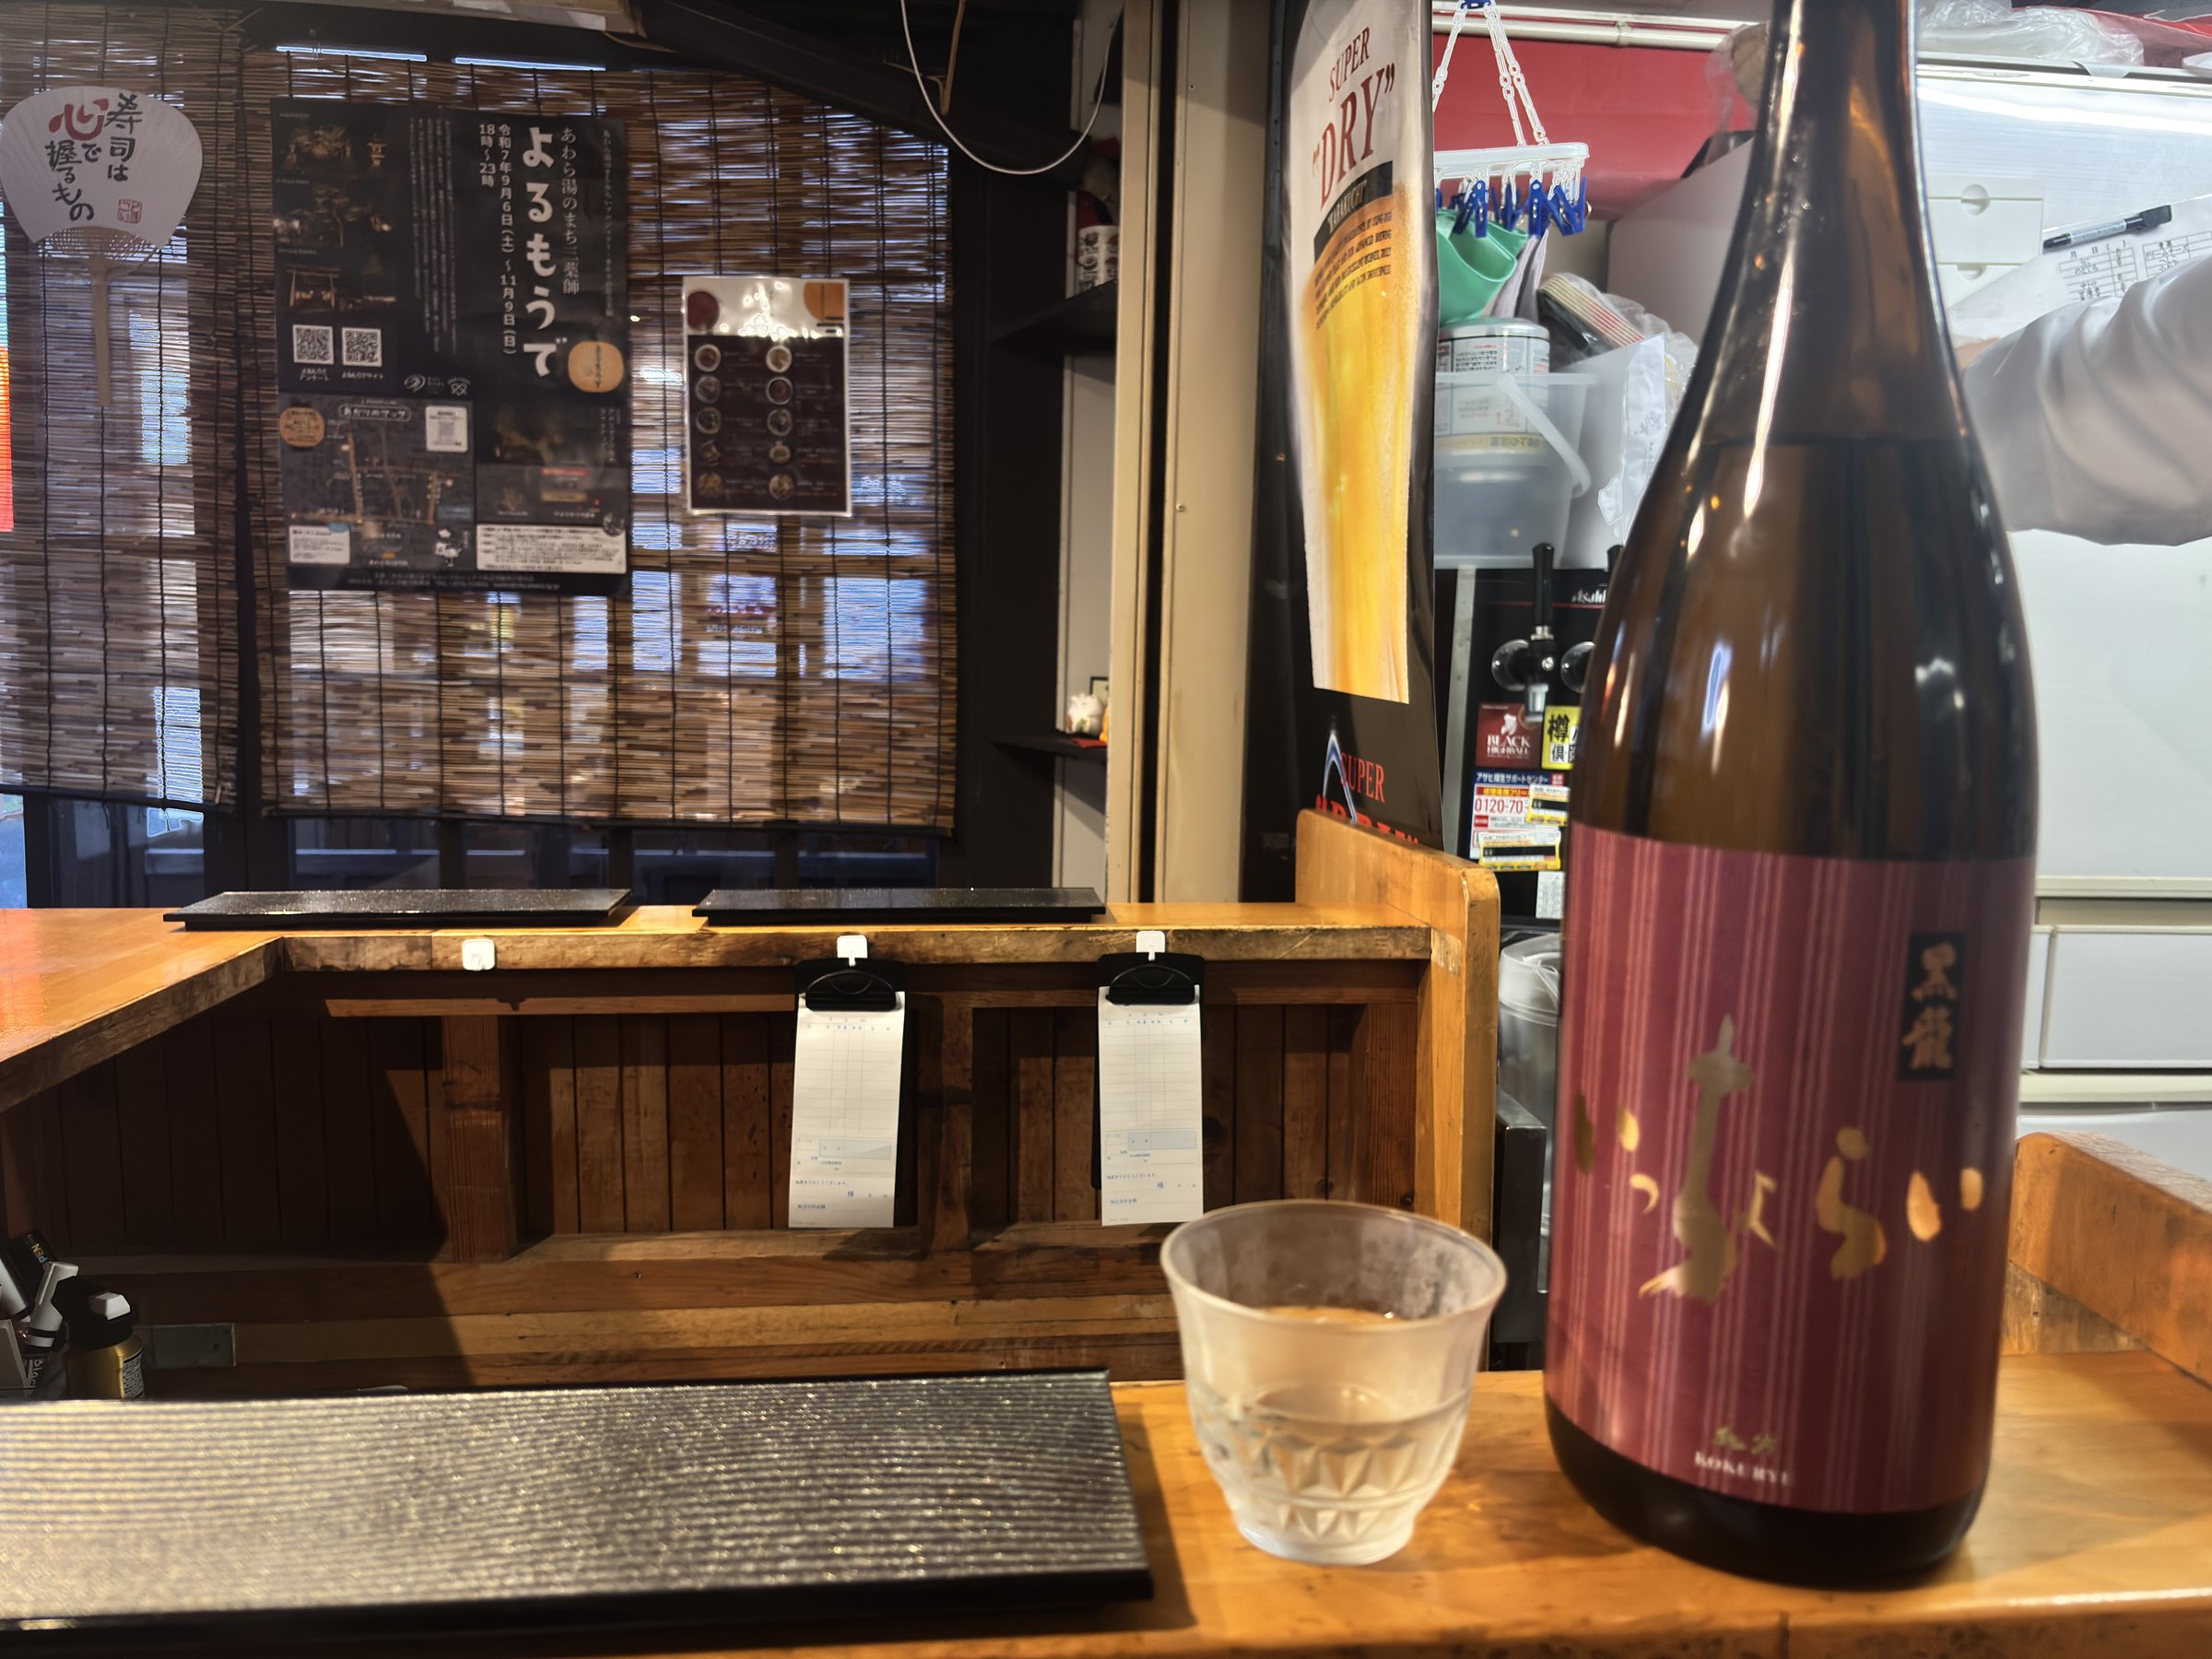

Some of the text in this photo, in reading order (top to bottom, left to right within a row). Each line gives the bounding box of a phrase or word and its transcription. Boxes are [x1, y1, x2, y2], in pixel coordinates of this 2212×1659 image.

[1328, 27, 1371, 102] SUPER
[104, 93, 143, 182] 寿司は
[44, 140, 94, 221] 握るもの
[523, 126, 568, 378] よるもうで
[1340, 753, 1385, 804] SUPER
[1487, 734, 1531, 748] BLACK
